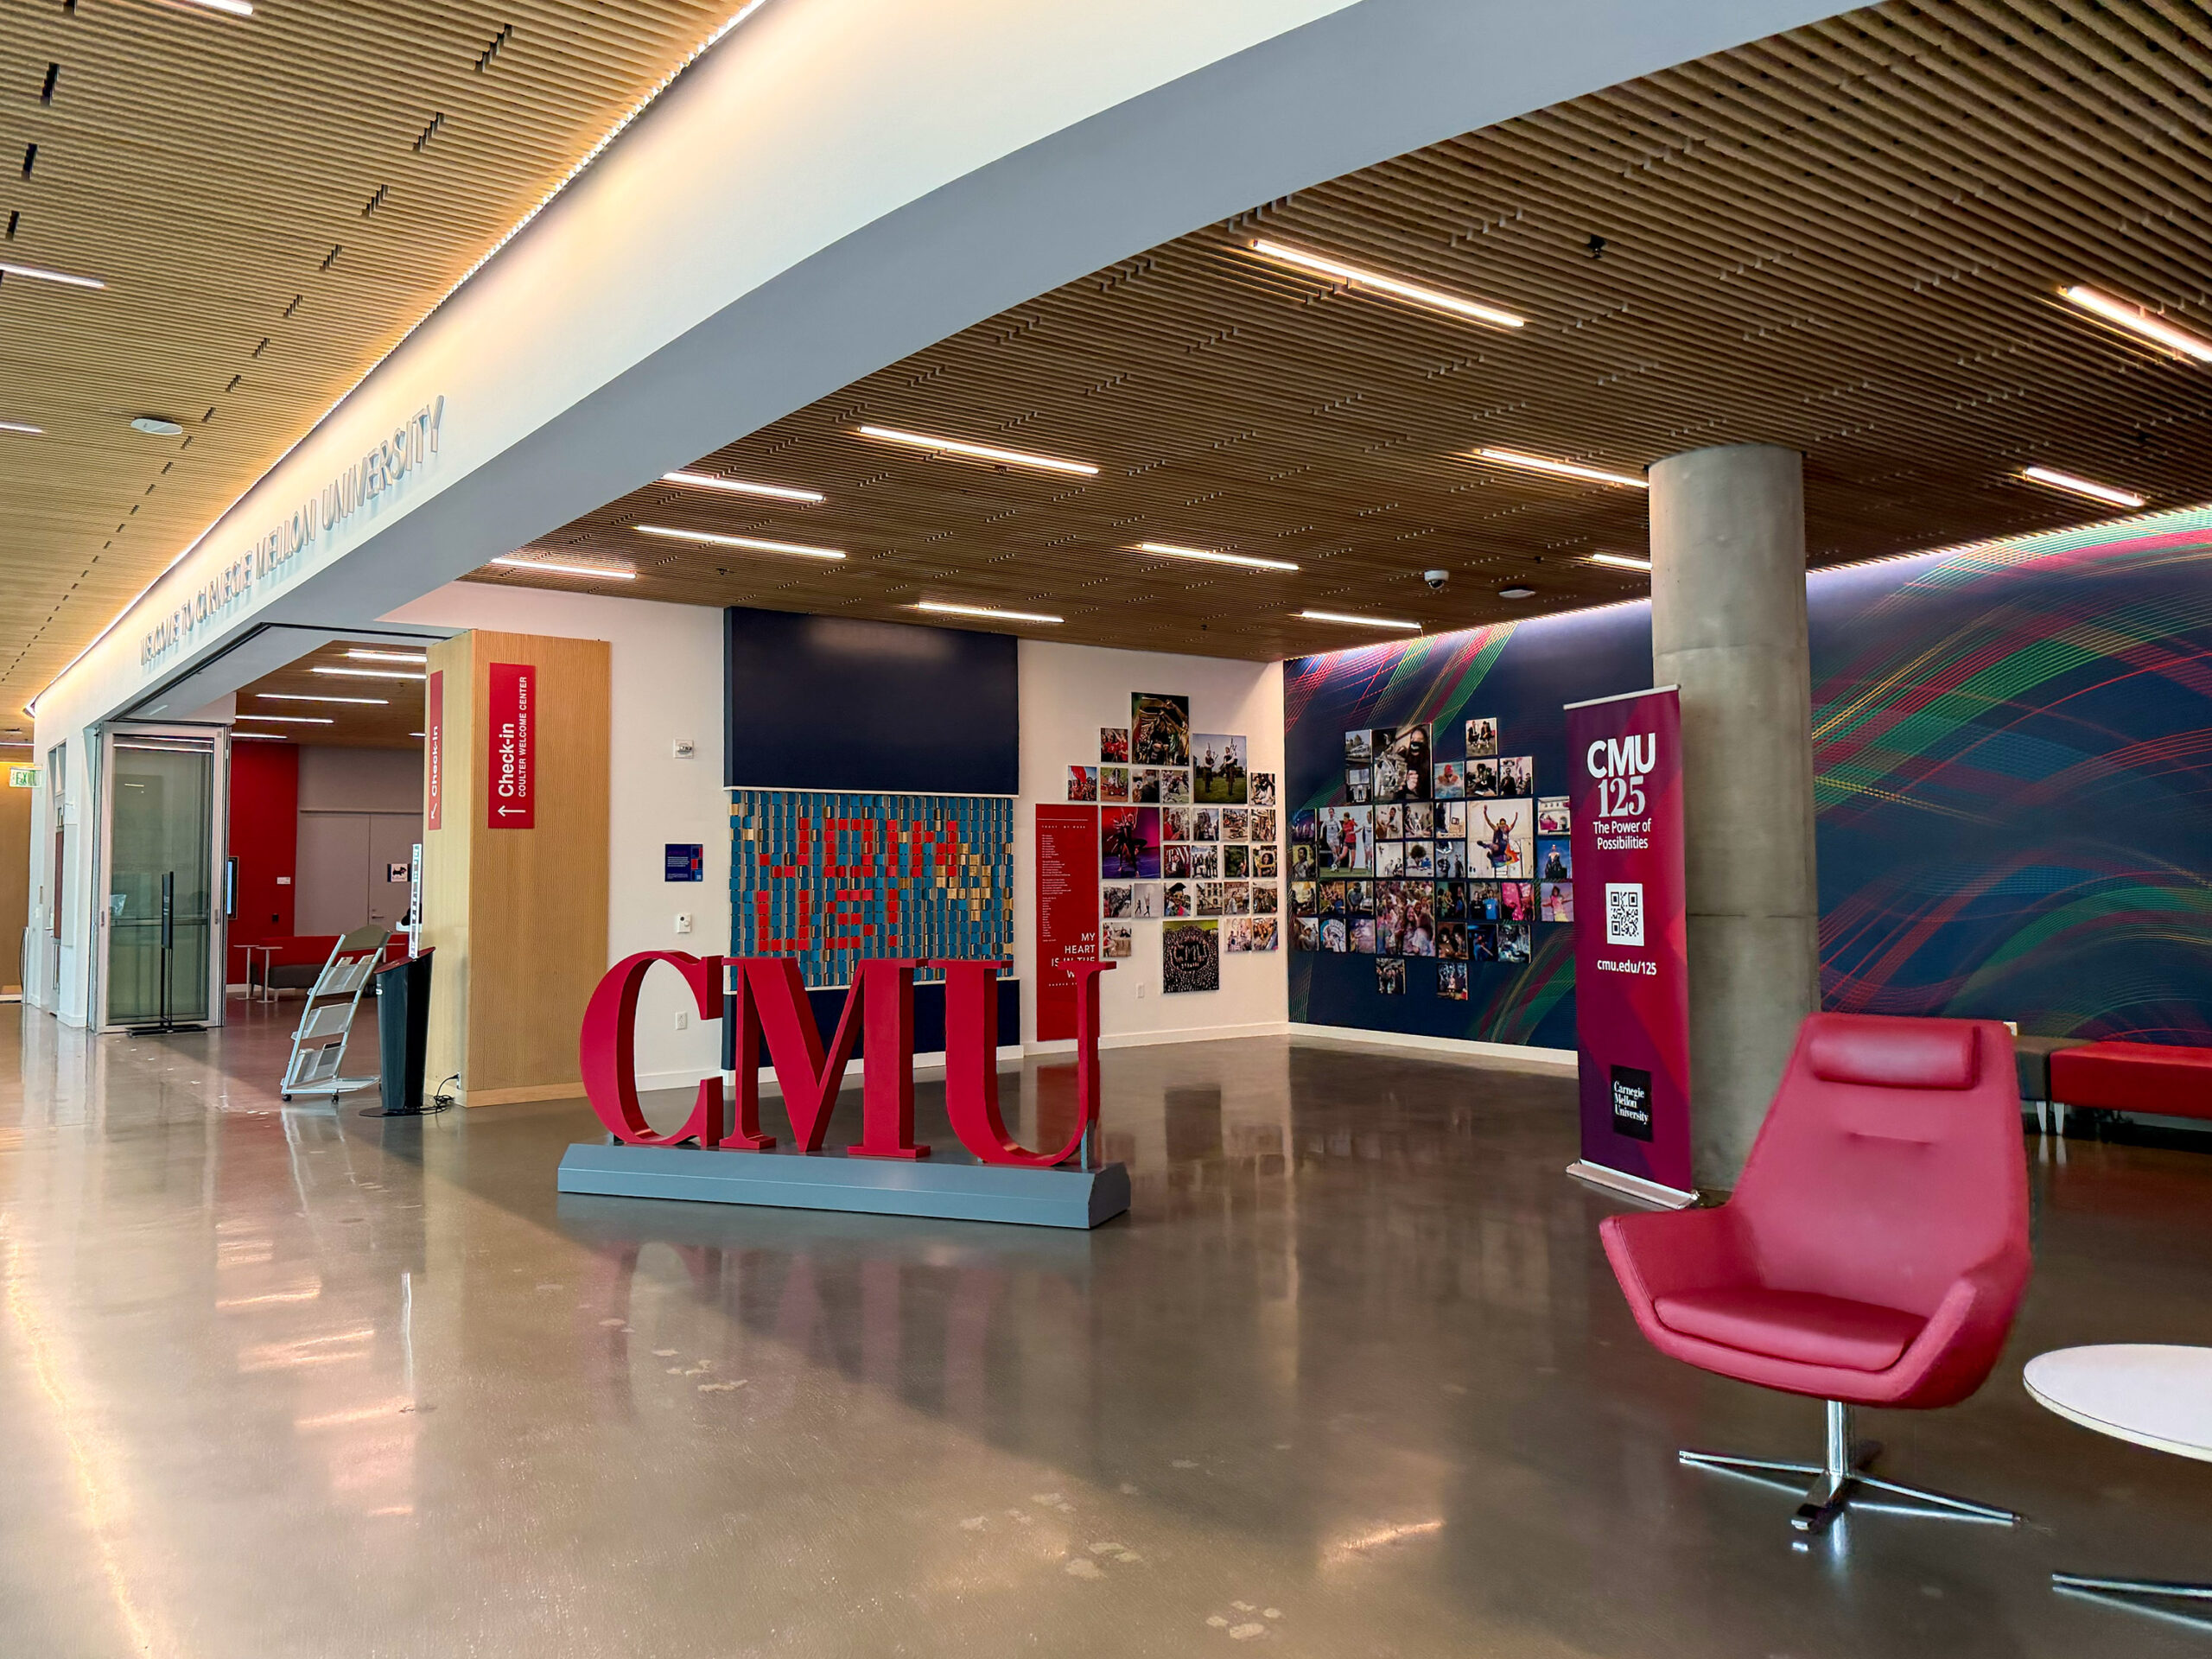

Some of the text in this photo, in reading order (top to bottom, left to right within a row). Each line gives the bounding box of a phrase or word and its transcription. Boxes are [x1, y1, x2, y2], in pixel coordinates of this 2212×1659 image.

[196, 550, 253, 624] CARNEGIE
[256, 499, 316, 580] MELLON
[321, 395, 444, 531] UNIVERSITY
[497, 723, 515, 798] Check-in
[1587, 733, 1656, 779] CMU
[518, 759, 527, 798] COULTER
[1598, 775, 1646, 817] 125
[1593, 818, 1652, 835] The Power of
[1597, 836, 1649, 849] Possibilities
[1081, 932, 1096, 942] MY
[1065, 944, 1096, 955] HEART
[1597, 958, 1657, 976] cmu.edu/125
[580, 950, 1116, 1166] CMU
[1614, 1080, 1645, 1099] Carnegie
[1614, 1093, 1637, 1109] Mellon
[1614, 1104, 1649, 1124] University
